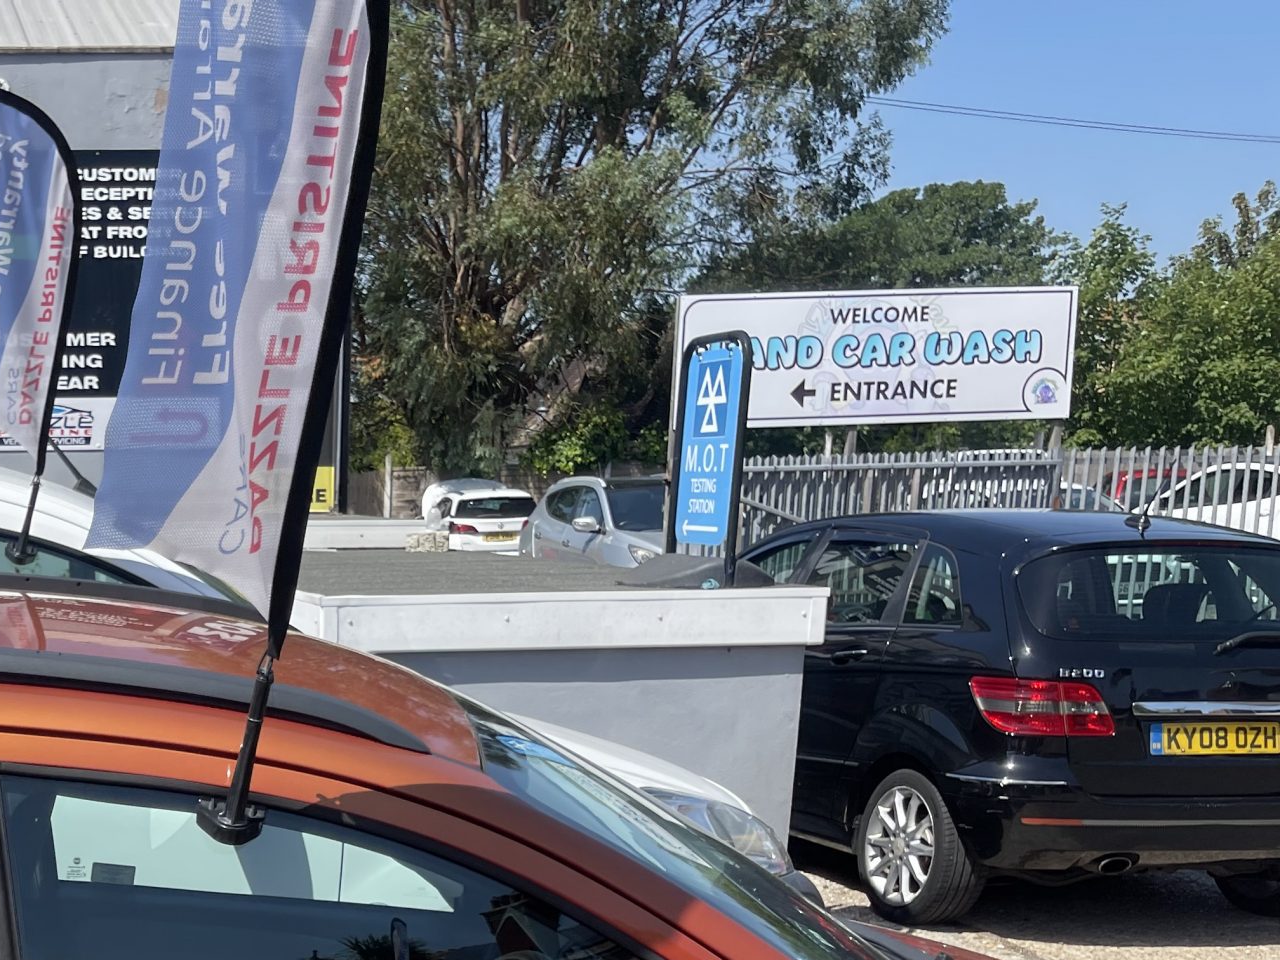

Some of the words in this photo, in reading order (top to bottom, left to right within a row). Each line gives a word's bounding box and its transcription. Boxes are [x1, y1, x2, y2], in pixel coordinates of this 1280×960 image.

[830, 306, 930, 324] WELCOME
[751, 334, 823, 370] AND
[830, 332, 917, 369] CAR
[923, 329, 1043, 367] WASH
[830, 378, 958, 403] ENTRANCE
[685, 444, 730, 473] M.O.T
[690, 478, 717, 494] TESTING
[687, 498, 715, 514] STATION
[1166, 726, 1228, 750] KY08
